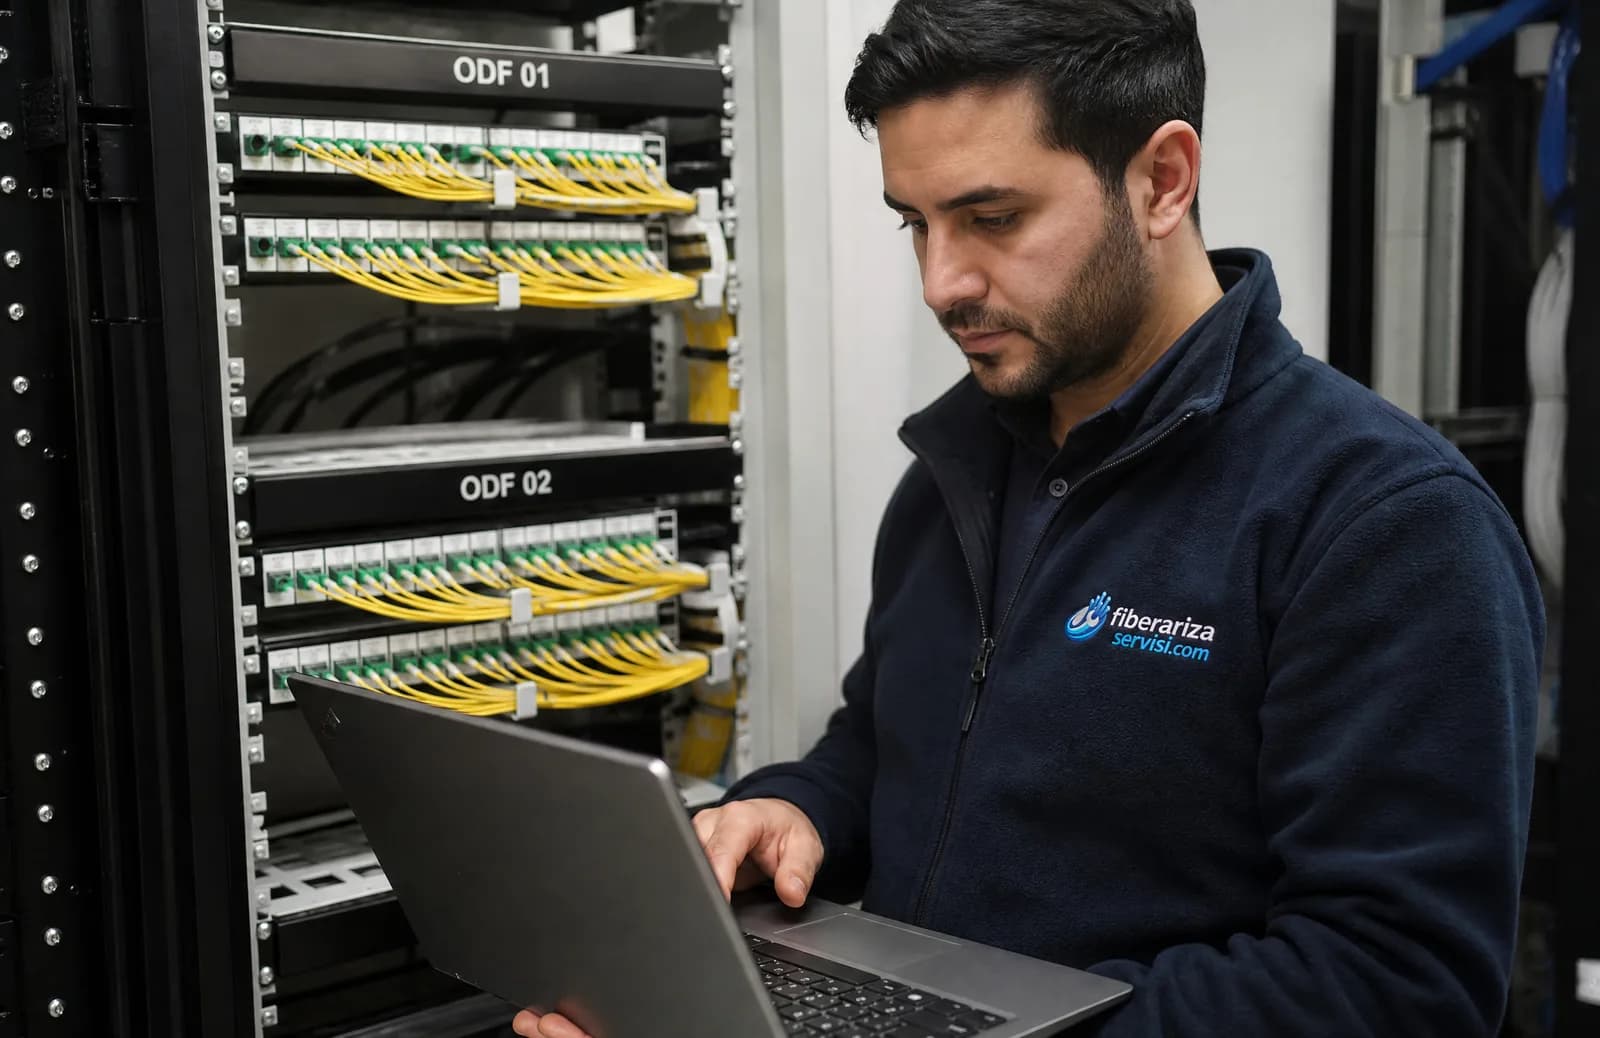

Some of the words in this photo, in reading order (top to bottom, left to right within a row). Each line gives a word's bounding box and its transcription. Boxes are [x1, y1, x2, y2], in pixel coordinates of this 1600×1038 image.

[453, 56, 513, 86] ODF
[520, 61, 549, 89] 01
[461, 472, 515, 501] ODF
[523, 469, 552, 495] 02
[1110, 606, 1215, 641] fiberariza
[1111, 632, 1210, 661] servisi.com
